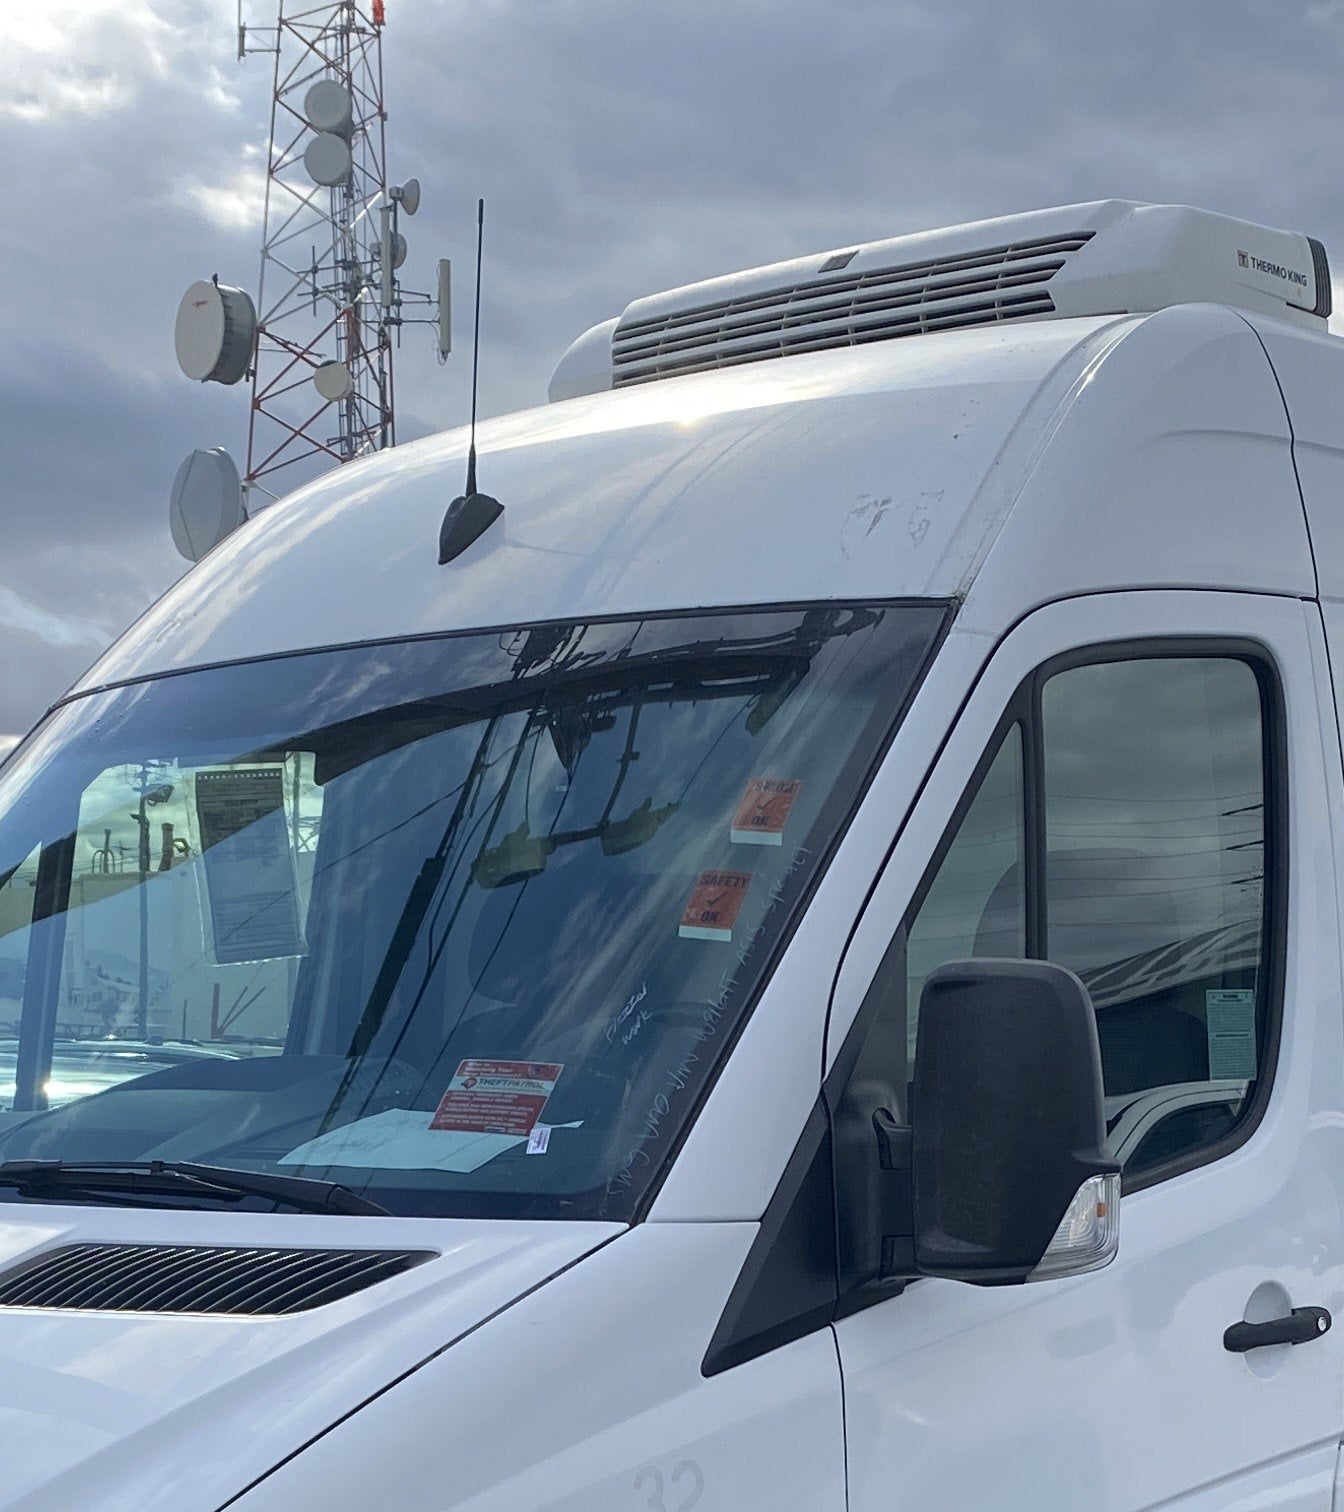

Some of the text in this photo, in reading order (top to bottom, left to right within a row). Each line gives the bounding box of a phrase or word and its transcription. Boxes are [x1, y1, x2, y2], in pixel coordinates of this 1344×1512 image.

[1250, 256, 1287, 279] THERMO
[1287, 270, 1308, 287] KING
[701, 874, 752, 890] SAFETY
[699, 910, 720, 923] OK
